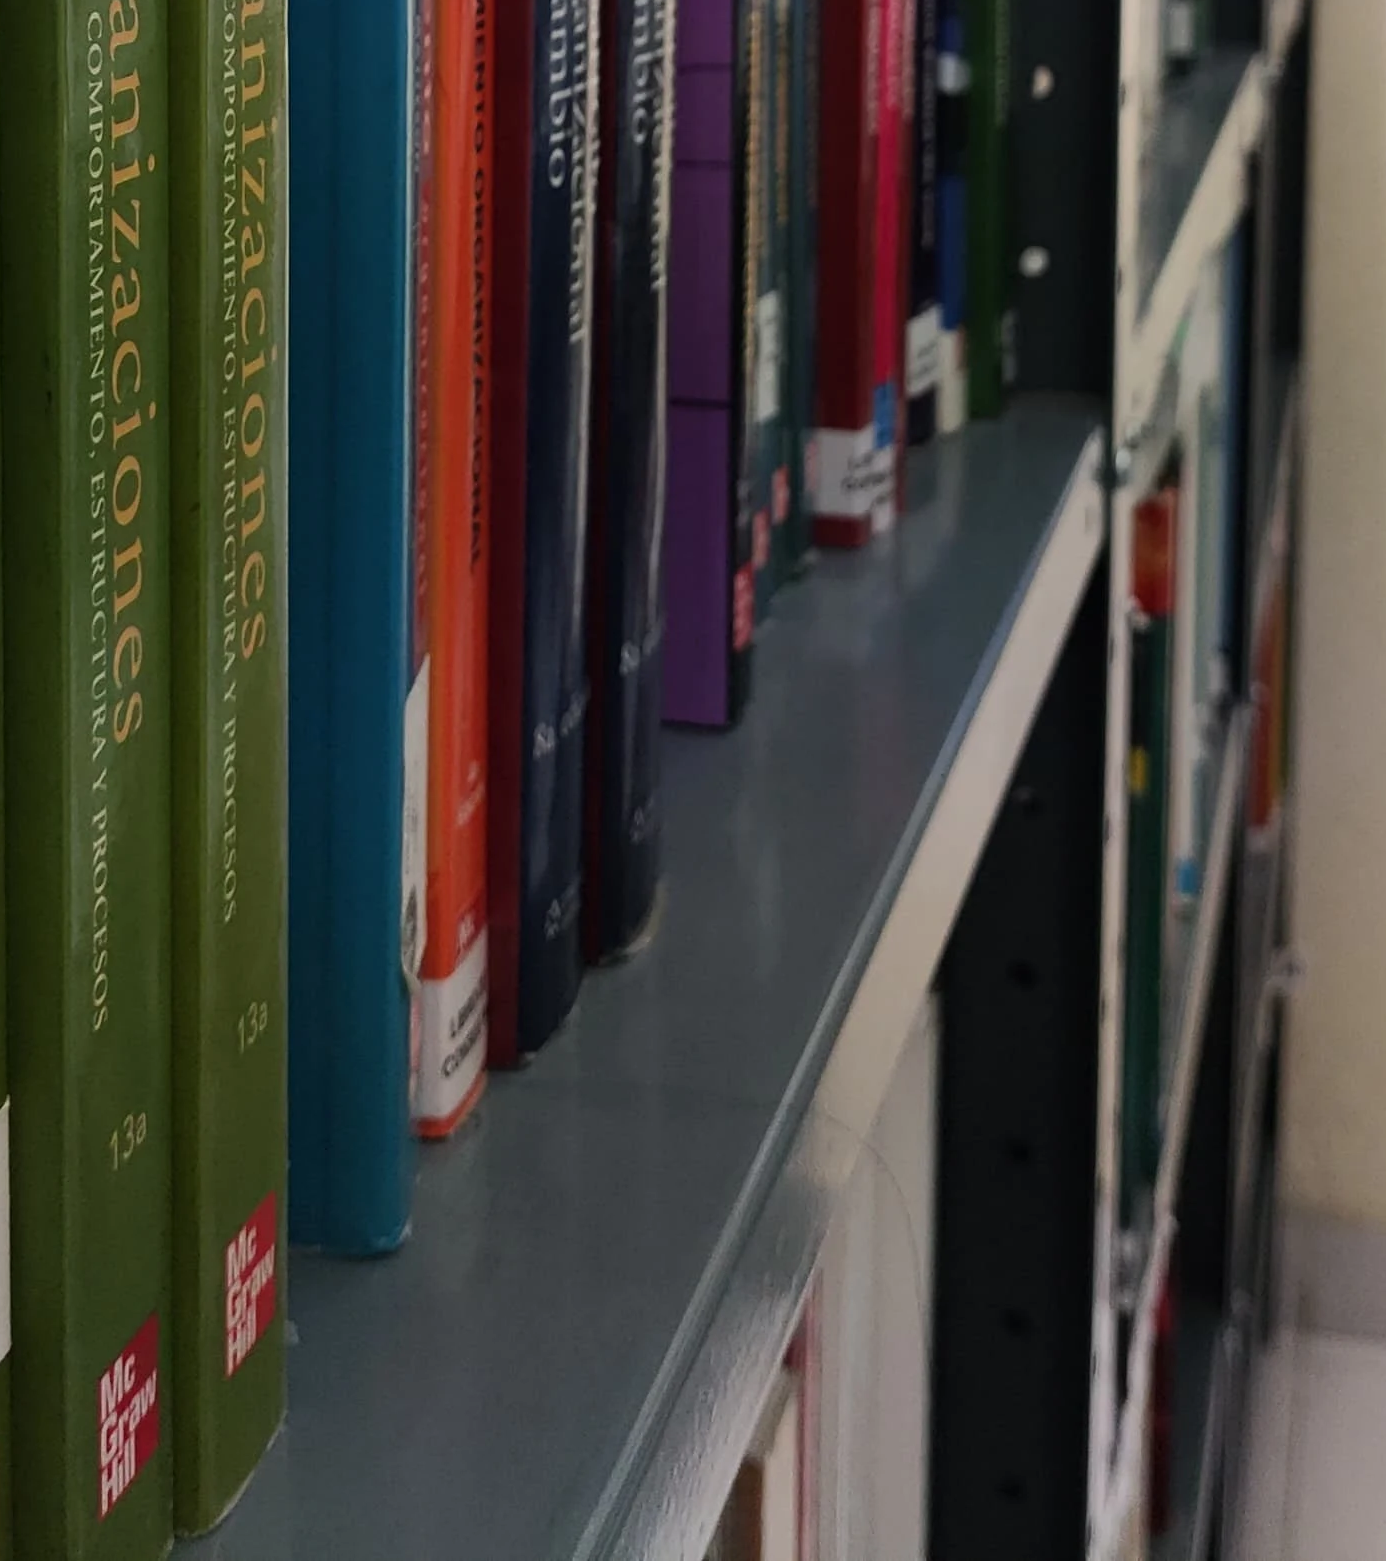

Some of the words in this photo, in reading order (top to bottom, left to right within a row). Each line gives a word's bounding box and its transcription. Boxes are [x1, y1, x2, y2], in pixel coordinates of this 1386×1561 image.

[86, 11, 107, 459] COMPORTAMIENTO,
[222, 405, 238, 675] ESTRUCTURA
[89, 472, 108, 761] ESTRUCTURA
[223, 683, 237, 702] Y
[91, 768, 108, 797] Y
[223, 711, 239, 924] PROCESOS
[91, 806, 109, 1032] PROCESOS
[238, 1001, 270, 1055] 13a
[109, 1110, 148, 1173] 13a
[227, 1225, 258, 1282] Mc
[227, 1244, 275, 1329] Graw
[228, 1308, 258, 1380] Hill
[100, 1352, 136, 1423] Mc
[100, 1368, 158, 1470] Graw
[101, 1435, 137, 1521] Hill
